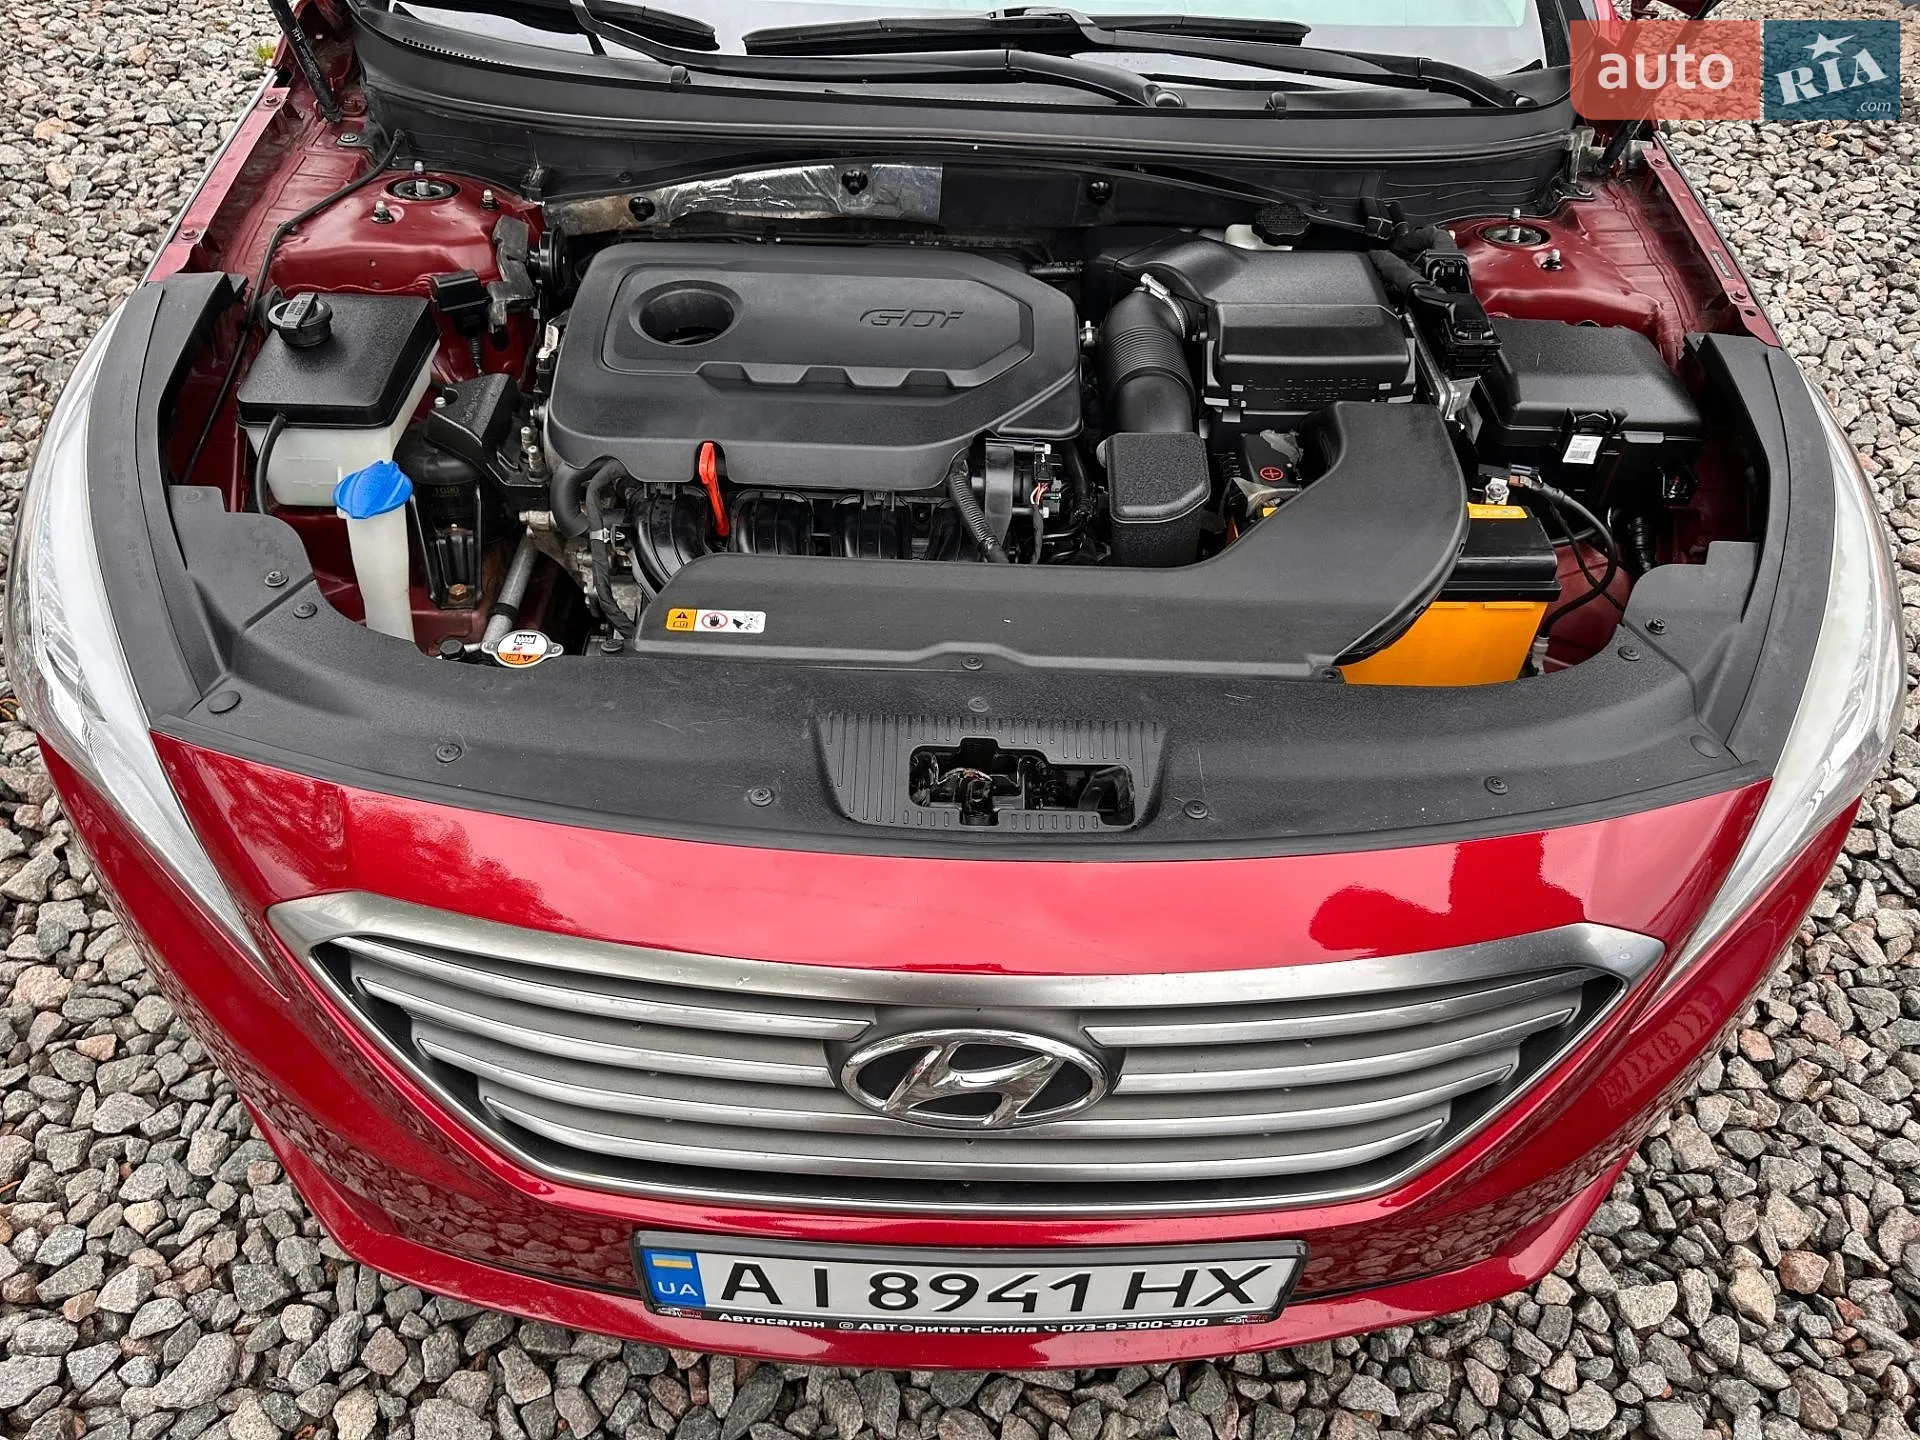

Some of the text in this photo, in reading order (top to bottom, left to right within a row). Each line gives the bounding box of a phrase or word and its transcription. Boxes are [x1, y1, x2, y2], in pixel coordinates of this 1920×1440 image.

[658, 1281, 698, 1297] UA
[869, 1270, 1091, 1313] 8941
[1122, 1264, 1272, 1310] HX
[718, 1313, 825, 1328] Автосалон
[1061, 1318, 1208, 1332] 073-9-300-300
